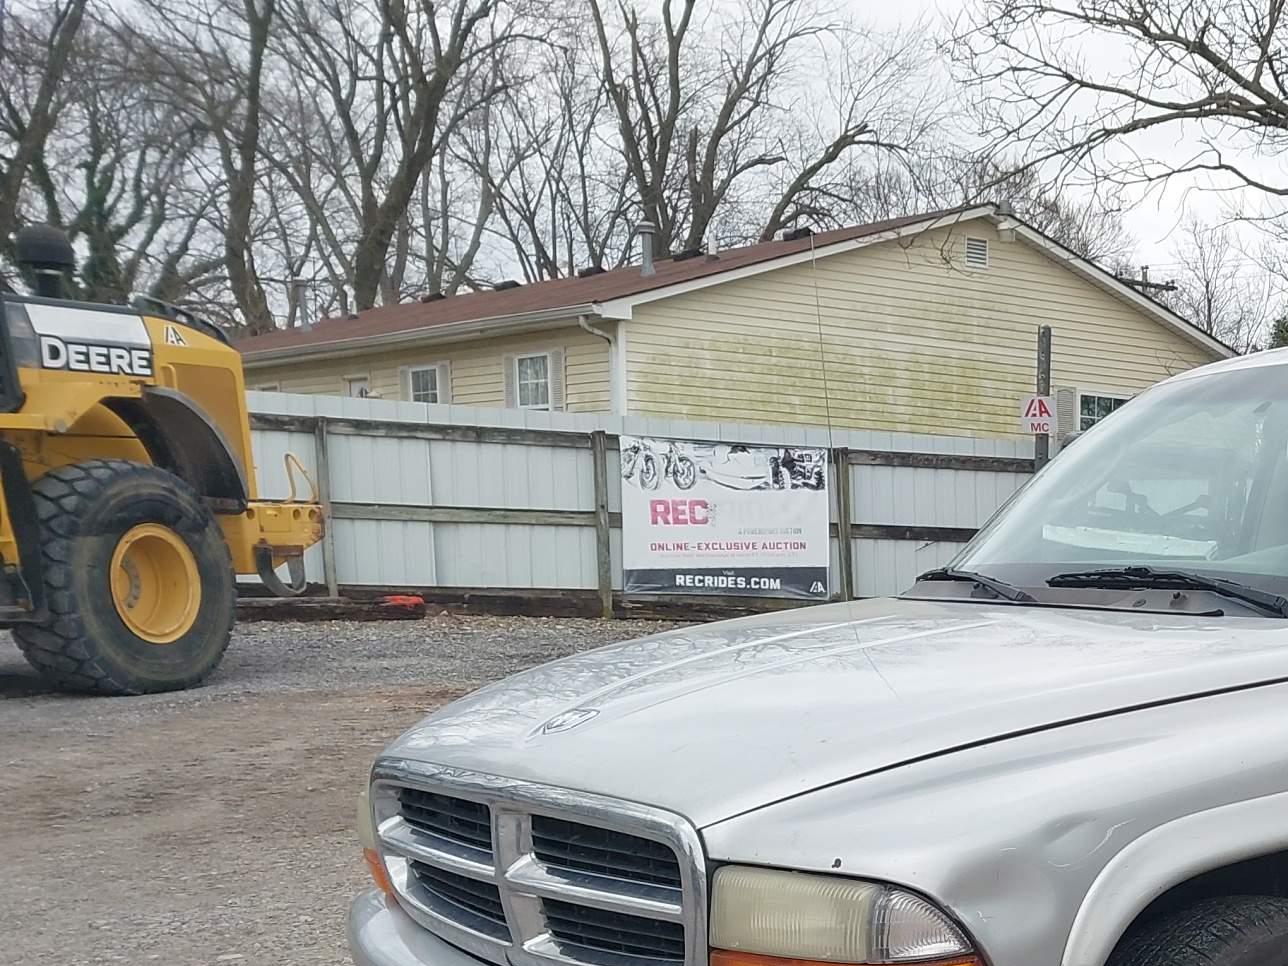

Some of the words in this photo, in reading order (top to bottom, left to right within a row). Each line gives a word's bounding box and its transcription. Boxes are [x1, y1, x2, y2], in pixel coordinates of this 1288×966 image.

[40, 336, 151, 375] DEERE
[1030, 422, 1050, 432] MC
[651, 499, 709, 525] REC
[650, 541, 758, 551] ONLINE-EXCLUSIVE
[761, 541, 807, 550] AUCTION
[675, 574, 781, 590] RECRIDES.COM
